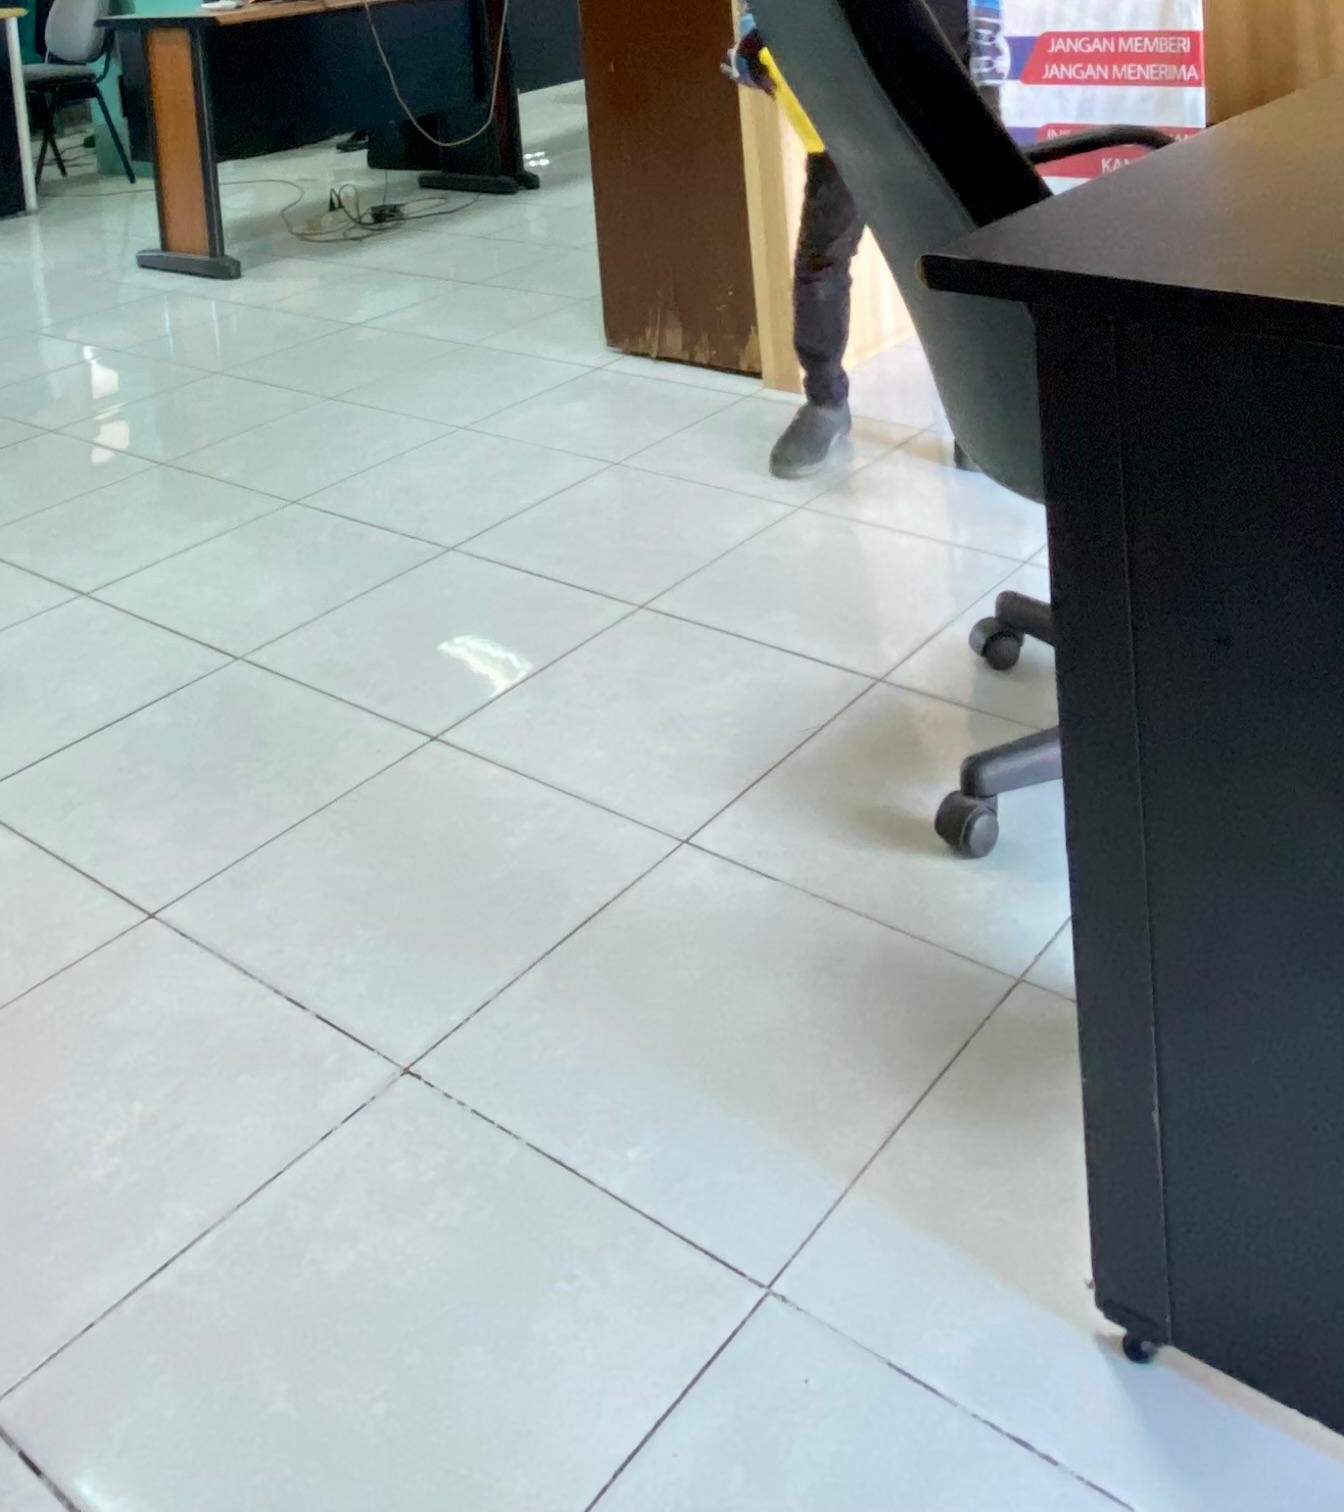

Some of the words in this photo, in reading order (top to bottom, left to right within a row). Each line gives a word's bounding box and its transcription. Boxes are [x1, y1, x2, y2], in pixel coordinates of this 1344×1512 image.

[1048, 36, 1115, 54] JANGAN
[1118, 36, 1191, 54] MEMBERI
[1042, 63, 1108, 81] JANGAN
[1112, 63, 1199, 81] MENERIMA
